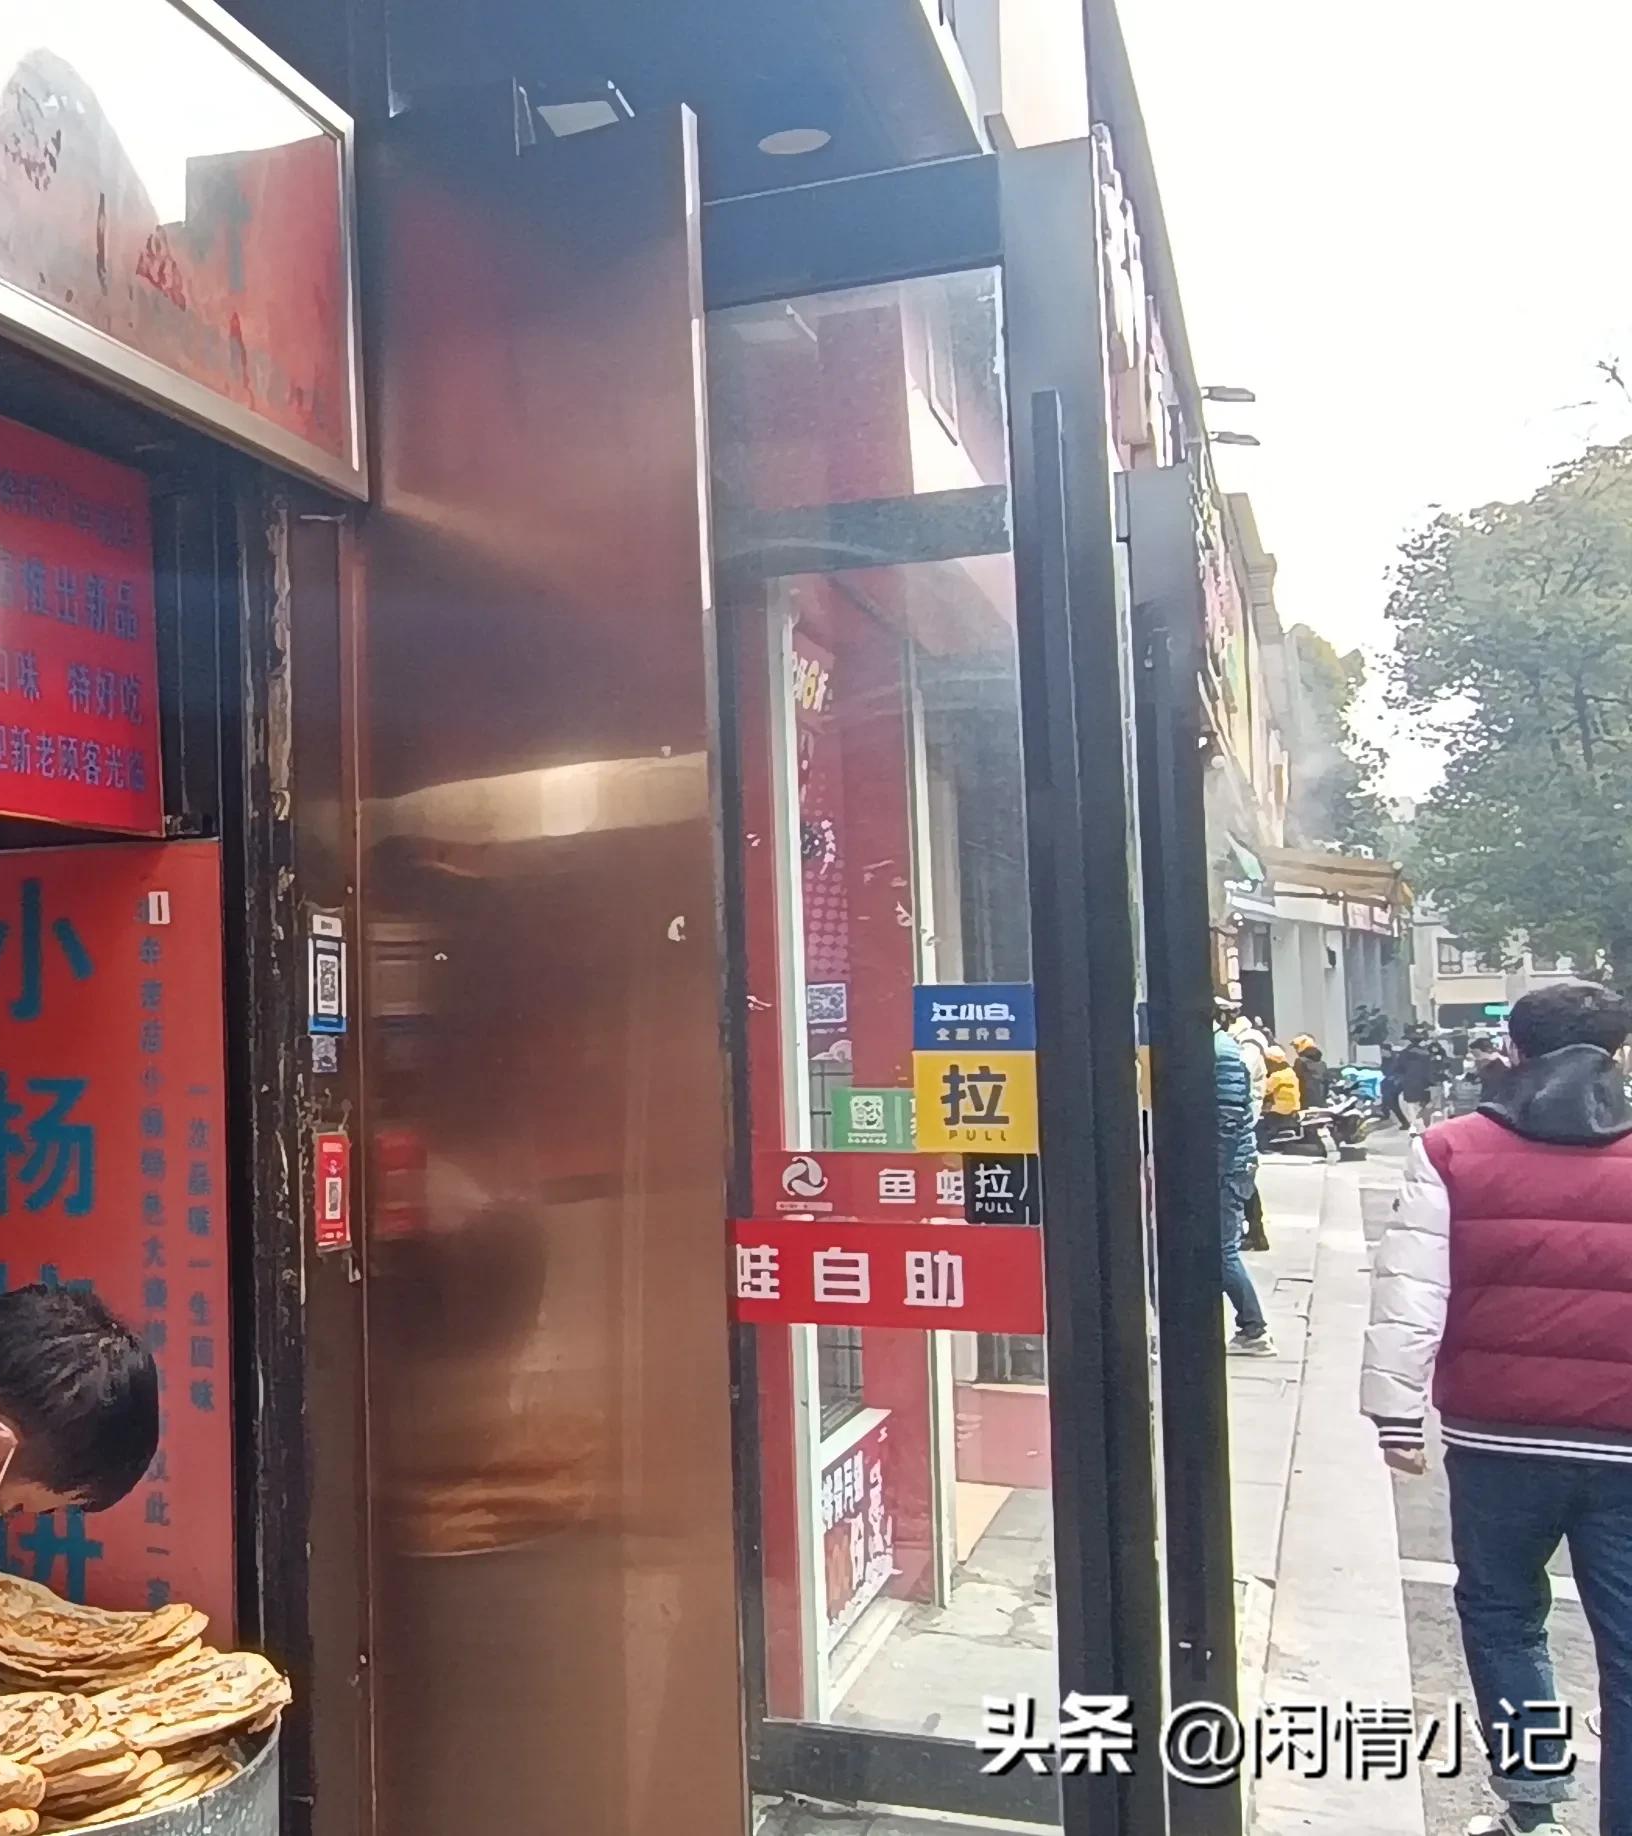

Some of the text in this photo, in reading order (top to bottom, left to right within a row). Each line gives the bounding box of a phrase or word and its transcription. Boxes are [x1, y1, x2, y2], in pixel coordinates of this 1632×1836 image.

[940, 1064, 1010, 1126] 拉
[949, 1129, 1007, 1142] PULL
[974, 1163, 1014, 1198] 拉
[975, 1201, 1015, 1214] PULL
